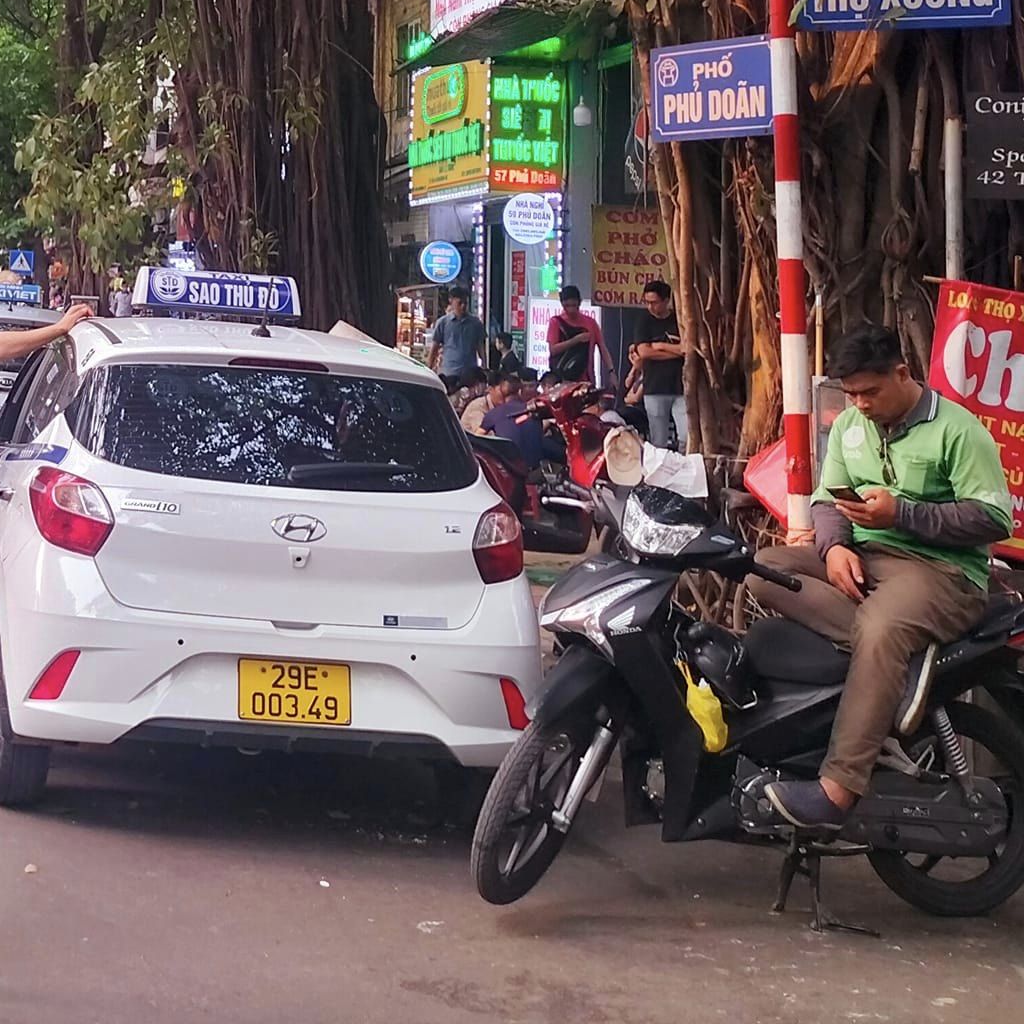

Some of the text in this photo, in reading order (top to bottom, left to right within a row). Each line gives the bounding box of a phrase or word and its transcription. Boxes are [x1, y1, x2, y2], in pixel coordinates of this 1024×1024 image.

[692, 52, 733, 80] PHỐ
[663, 81, 766, 125] PHỦ DOÃN
[494, 169, 508, 182] 57
[509, 167, 529, 184] Phủ
[530, 170, 557, 185] Doãn
[976, 170, 1006, 186] 42
[607, 228, 658, 246] PHỞ
[597, 248, 667, 267] CHÁO
[162, 277, 179, 287] STD
[597, 267, 630, 285] BÚN
[188, 281, 221, 305] SAO
[224, 280, 255, 308] THỦ
[594, 288, 625, 305] CƠM
[983, 297, 1016, 324] THỌ
[534, 330, 545, 341] 59
[943, 320, 1024, 412] Ch
[610, 626, 643, 636] HONDA
[271, 664, 318, 691] 29E
[251, 692, 339, 721] 003.49
